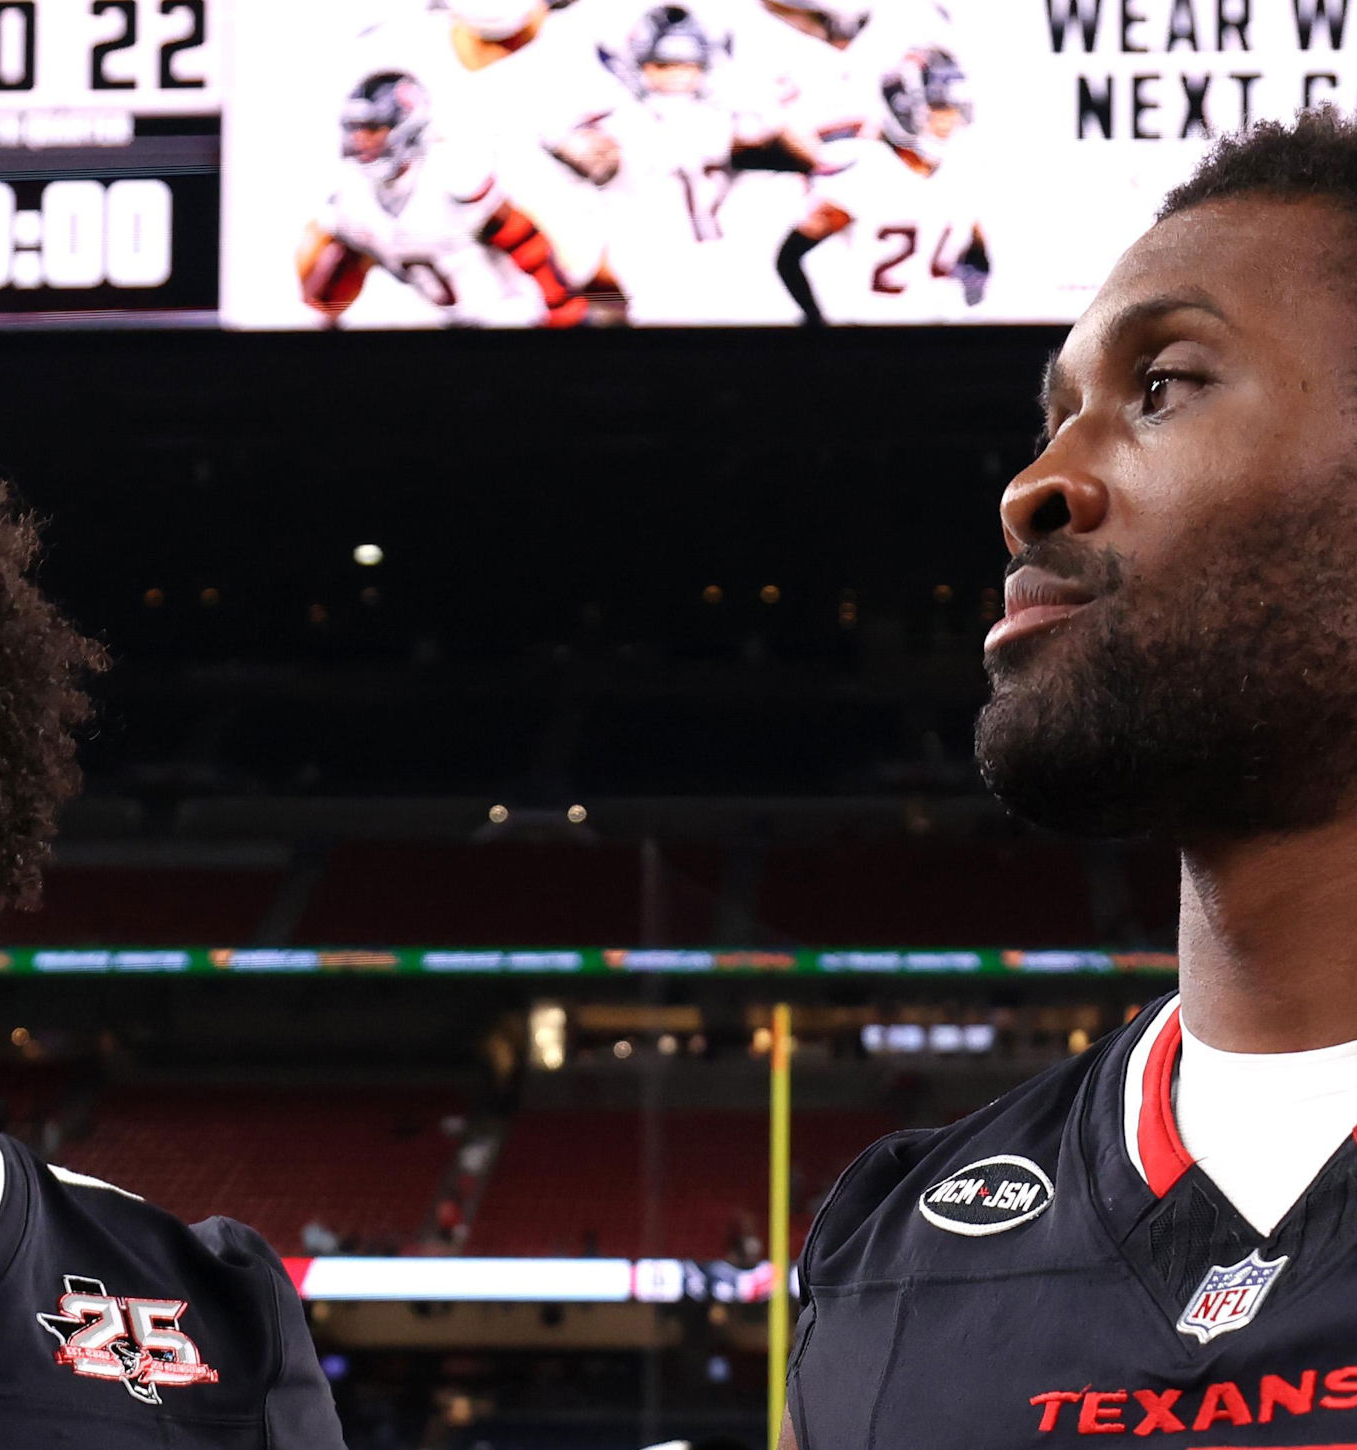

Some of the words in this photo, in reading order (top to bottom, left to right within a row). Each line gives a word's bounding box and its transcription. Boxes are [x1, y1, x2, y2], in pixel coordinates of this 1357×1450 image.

[90, 0, 207, 90] 22
[1047, 0, 1252, 53] WEAR
[1078, 72, 1261, 139] NEXT
[927, 1178, 984, 1205] RCM
[982, 1180, 1041, 1211] JSM
[1192, 1288, 1250, 1322] NFL
[58, 1292, 203, 1384] 25
